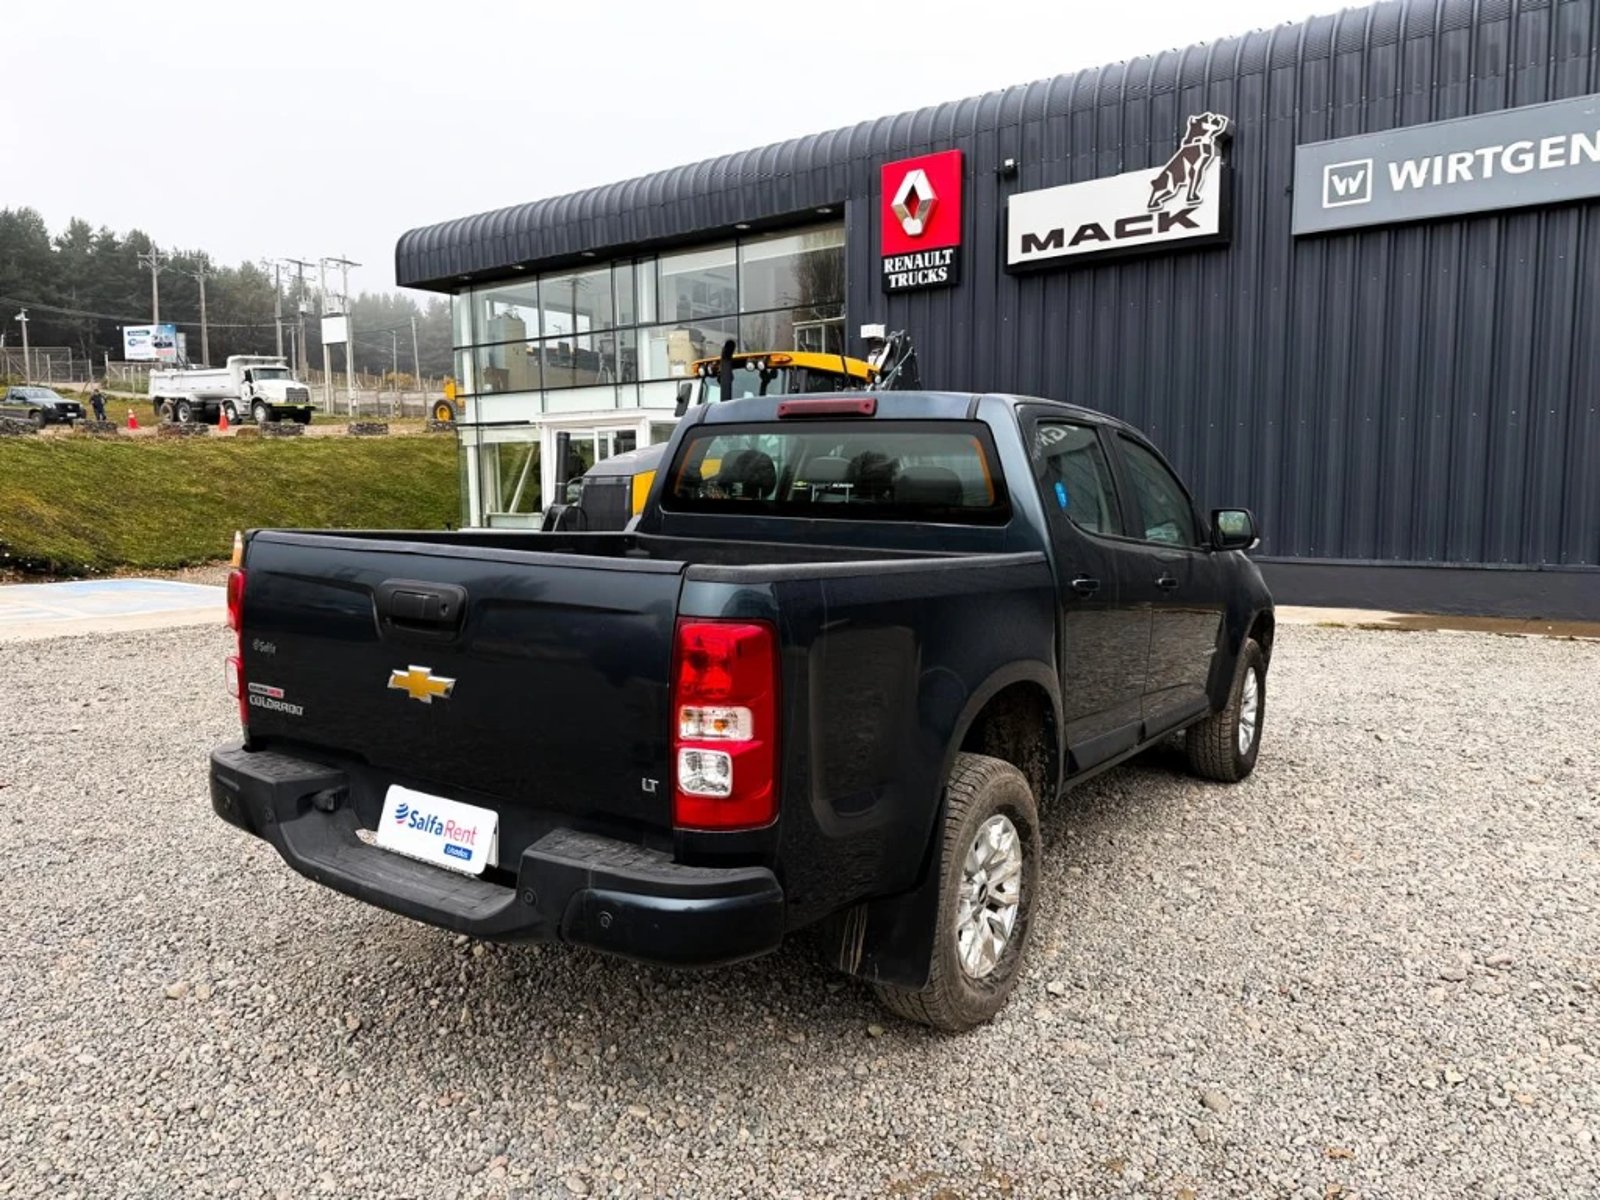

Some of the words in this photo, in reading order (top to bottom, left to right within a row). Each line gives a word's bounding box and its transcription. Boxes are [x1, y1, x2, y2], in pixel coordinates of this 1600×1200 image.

[1388, 130, 1600, 191] WIRTGEN
[1021, 207, 1200, 254] MACK
[883, 248, 954, 273] RENAULT
[888, 266, 948, 288] TRUCKS
[249, 694, 304, 716] COLORADO
[641, 777, 659, 792] LT
